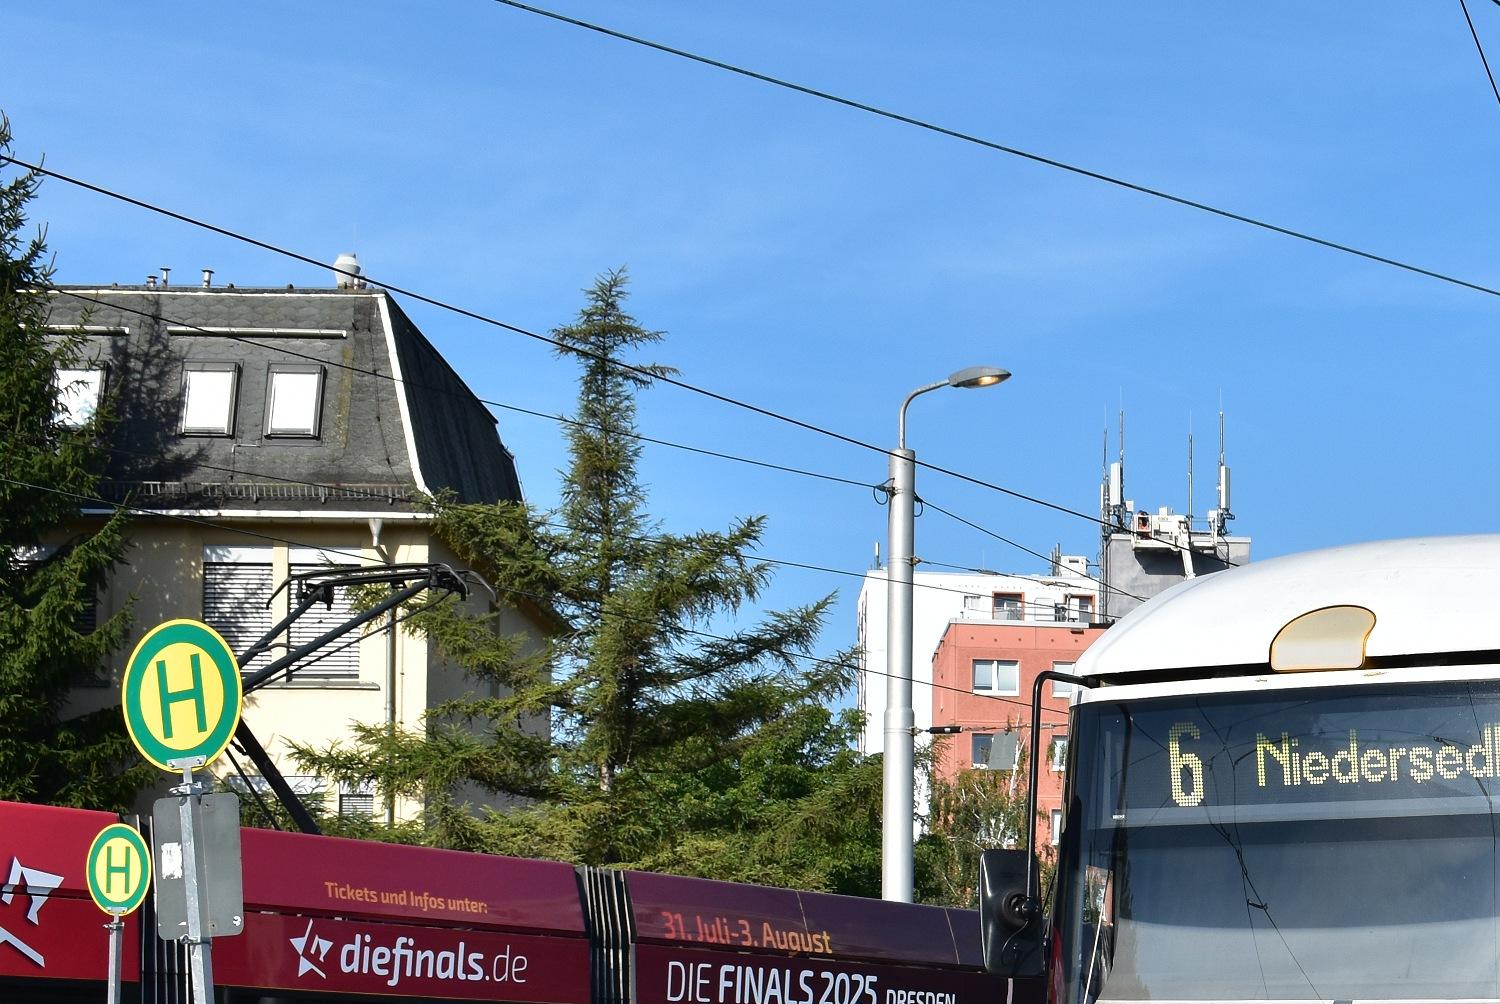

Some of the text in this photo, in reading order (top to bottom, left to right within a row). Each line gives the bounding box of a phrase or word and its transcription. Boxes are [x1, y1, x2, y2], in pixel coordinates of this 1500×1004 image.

[155, 652, 208, 740] H
[1167, 721, 1206, 808] 6
[105, 845, 131, 895] H
[324, 881, 488, 914] Tickets und Infos unter:
[660, 911, 692, 942] 31.
[762, 922, 833, 957] August
[340, 934, 528, 987] diefinals.de
[666, 960, 712, 1002] DIE
